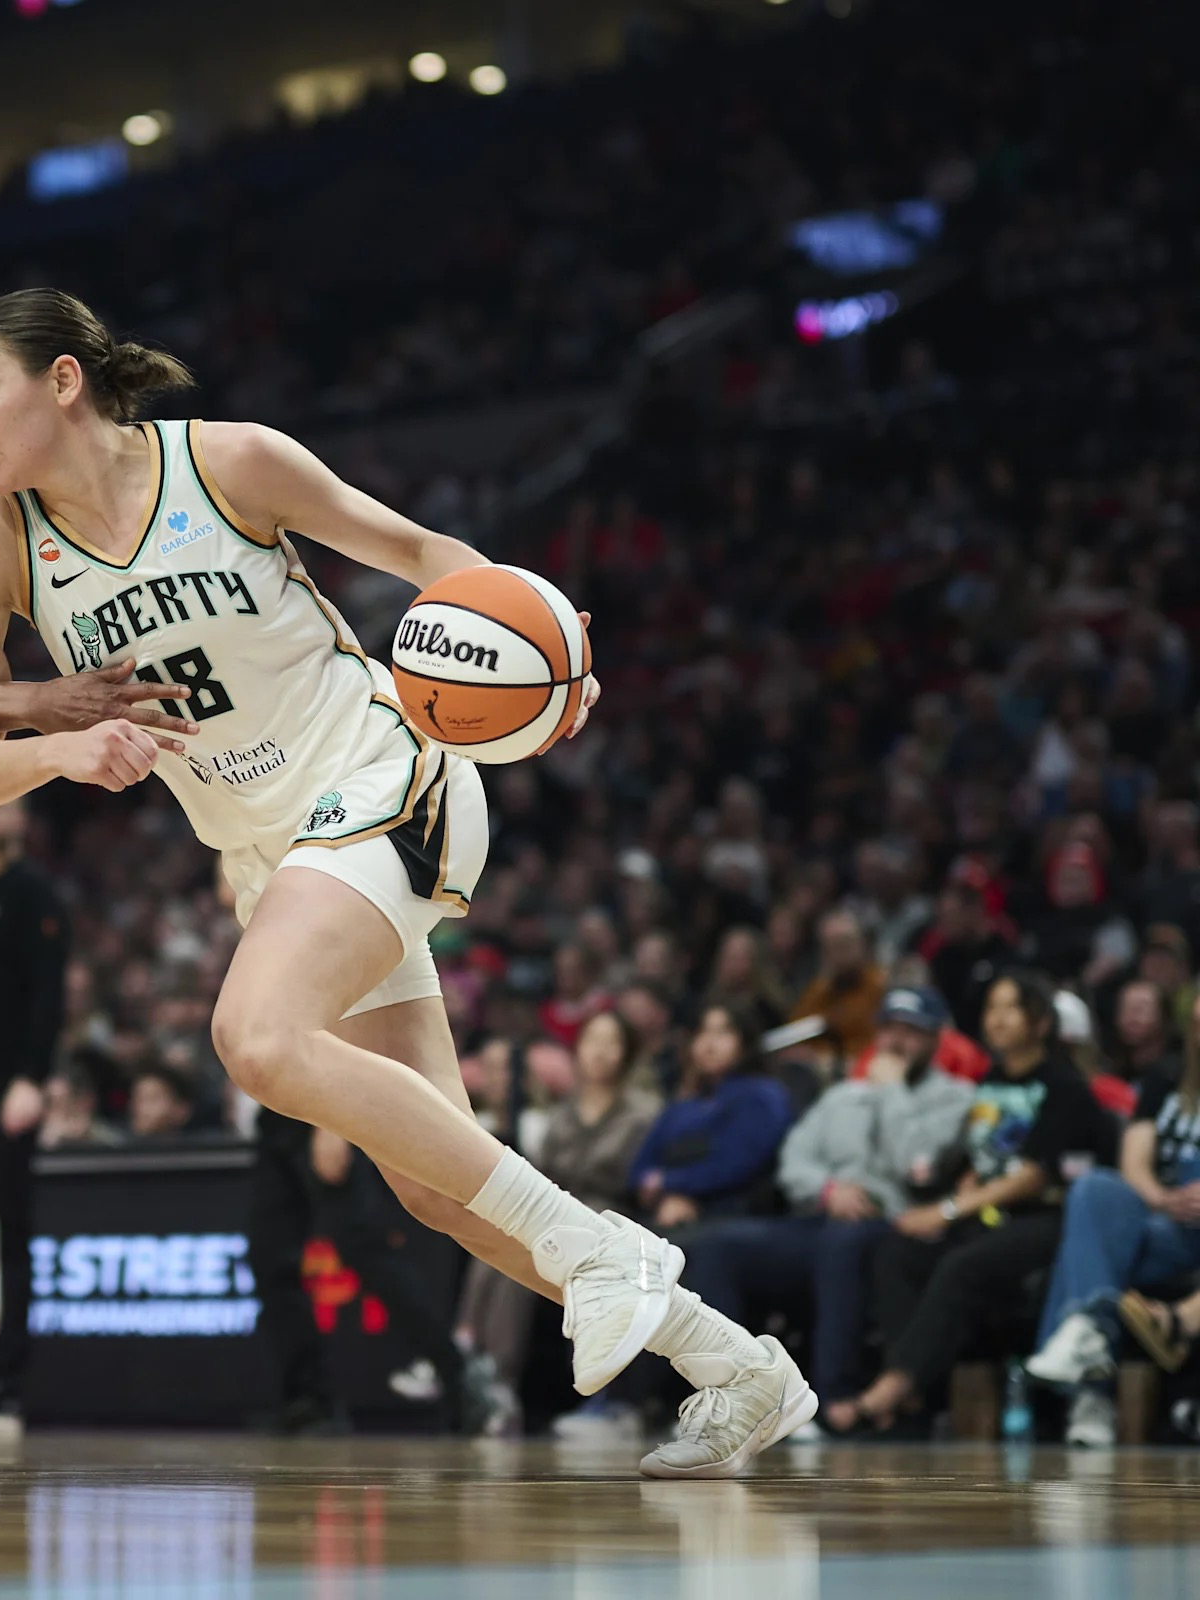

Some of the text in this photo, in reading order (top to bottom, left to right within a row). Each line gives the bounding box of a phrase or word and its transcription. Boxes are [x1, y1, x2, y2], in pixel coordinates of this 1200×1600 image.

[161, 522, 214, 555] BARCLAYS
[398, 619, 499, 672] Wilson
[136, 646, 235, 722] 18
[211, 736, 278, 773] Liberty
[221, 749, 287, 786] Mutual
